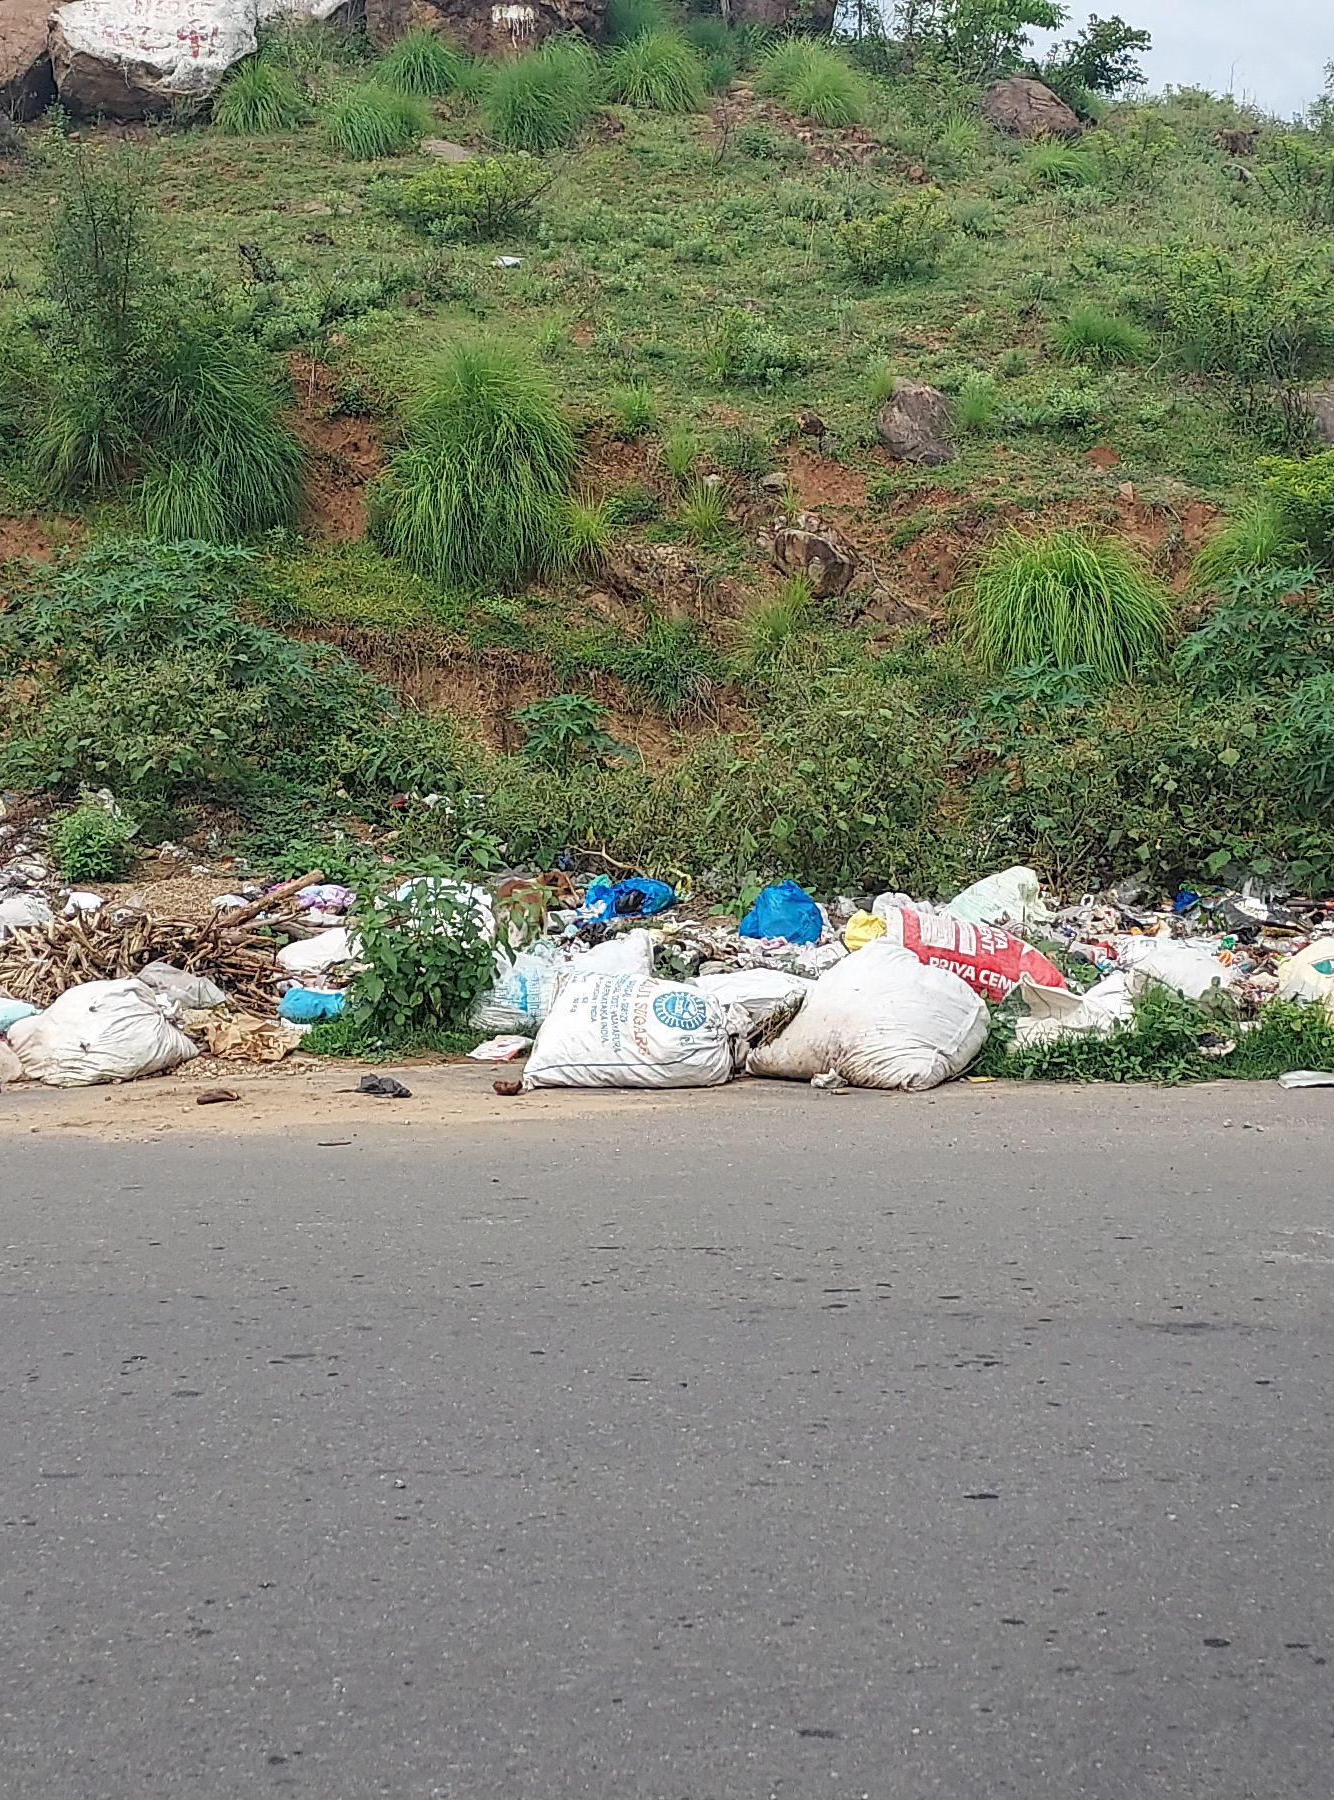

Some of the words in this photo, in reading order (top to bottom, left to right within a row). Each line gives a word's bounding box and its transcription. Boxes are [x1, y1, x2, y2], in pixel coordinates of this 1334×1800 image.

[929, 956, 976, 981] PRIYA
[600, 1021, 610, 1044] INDIA
[633, 1002, 651, 1056] SUGARS
